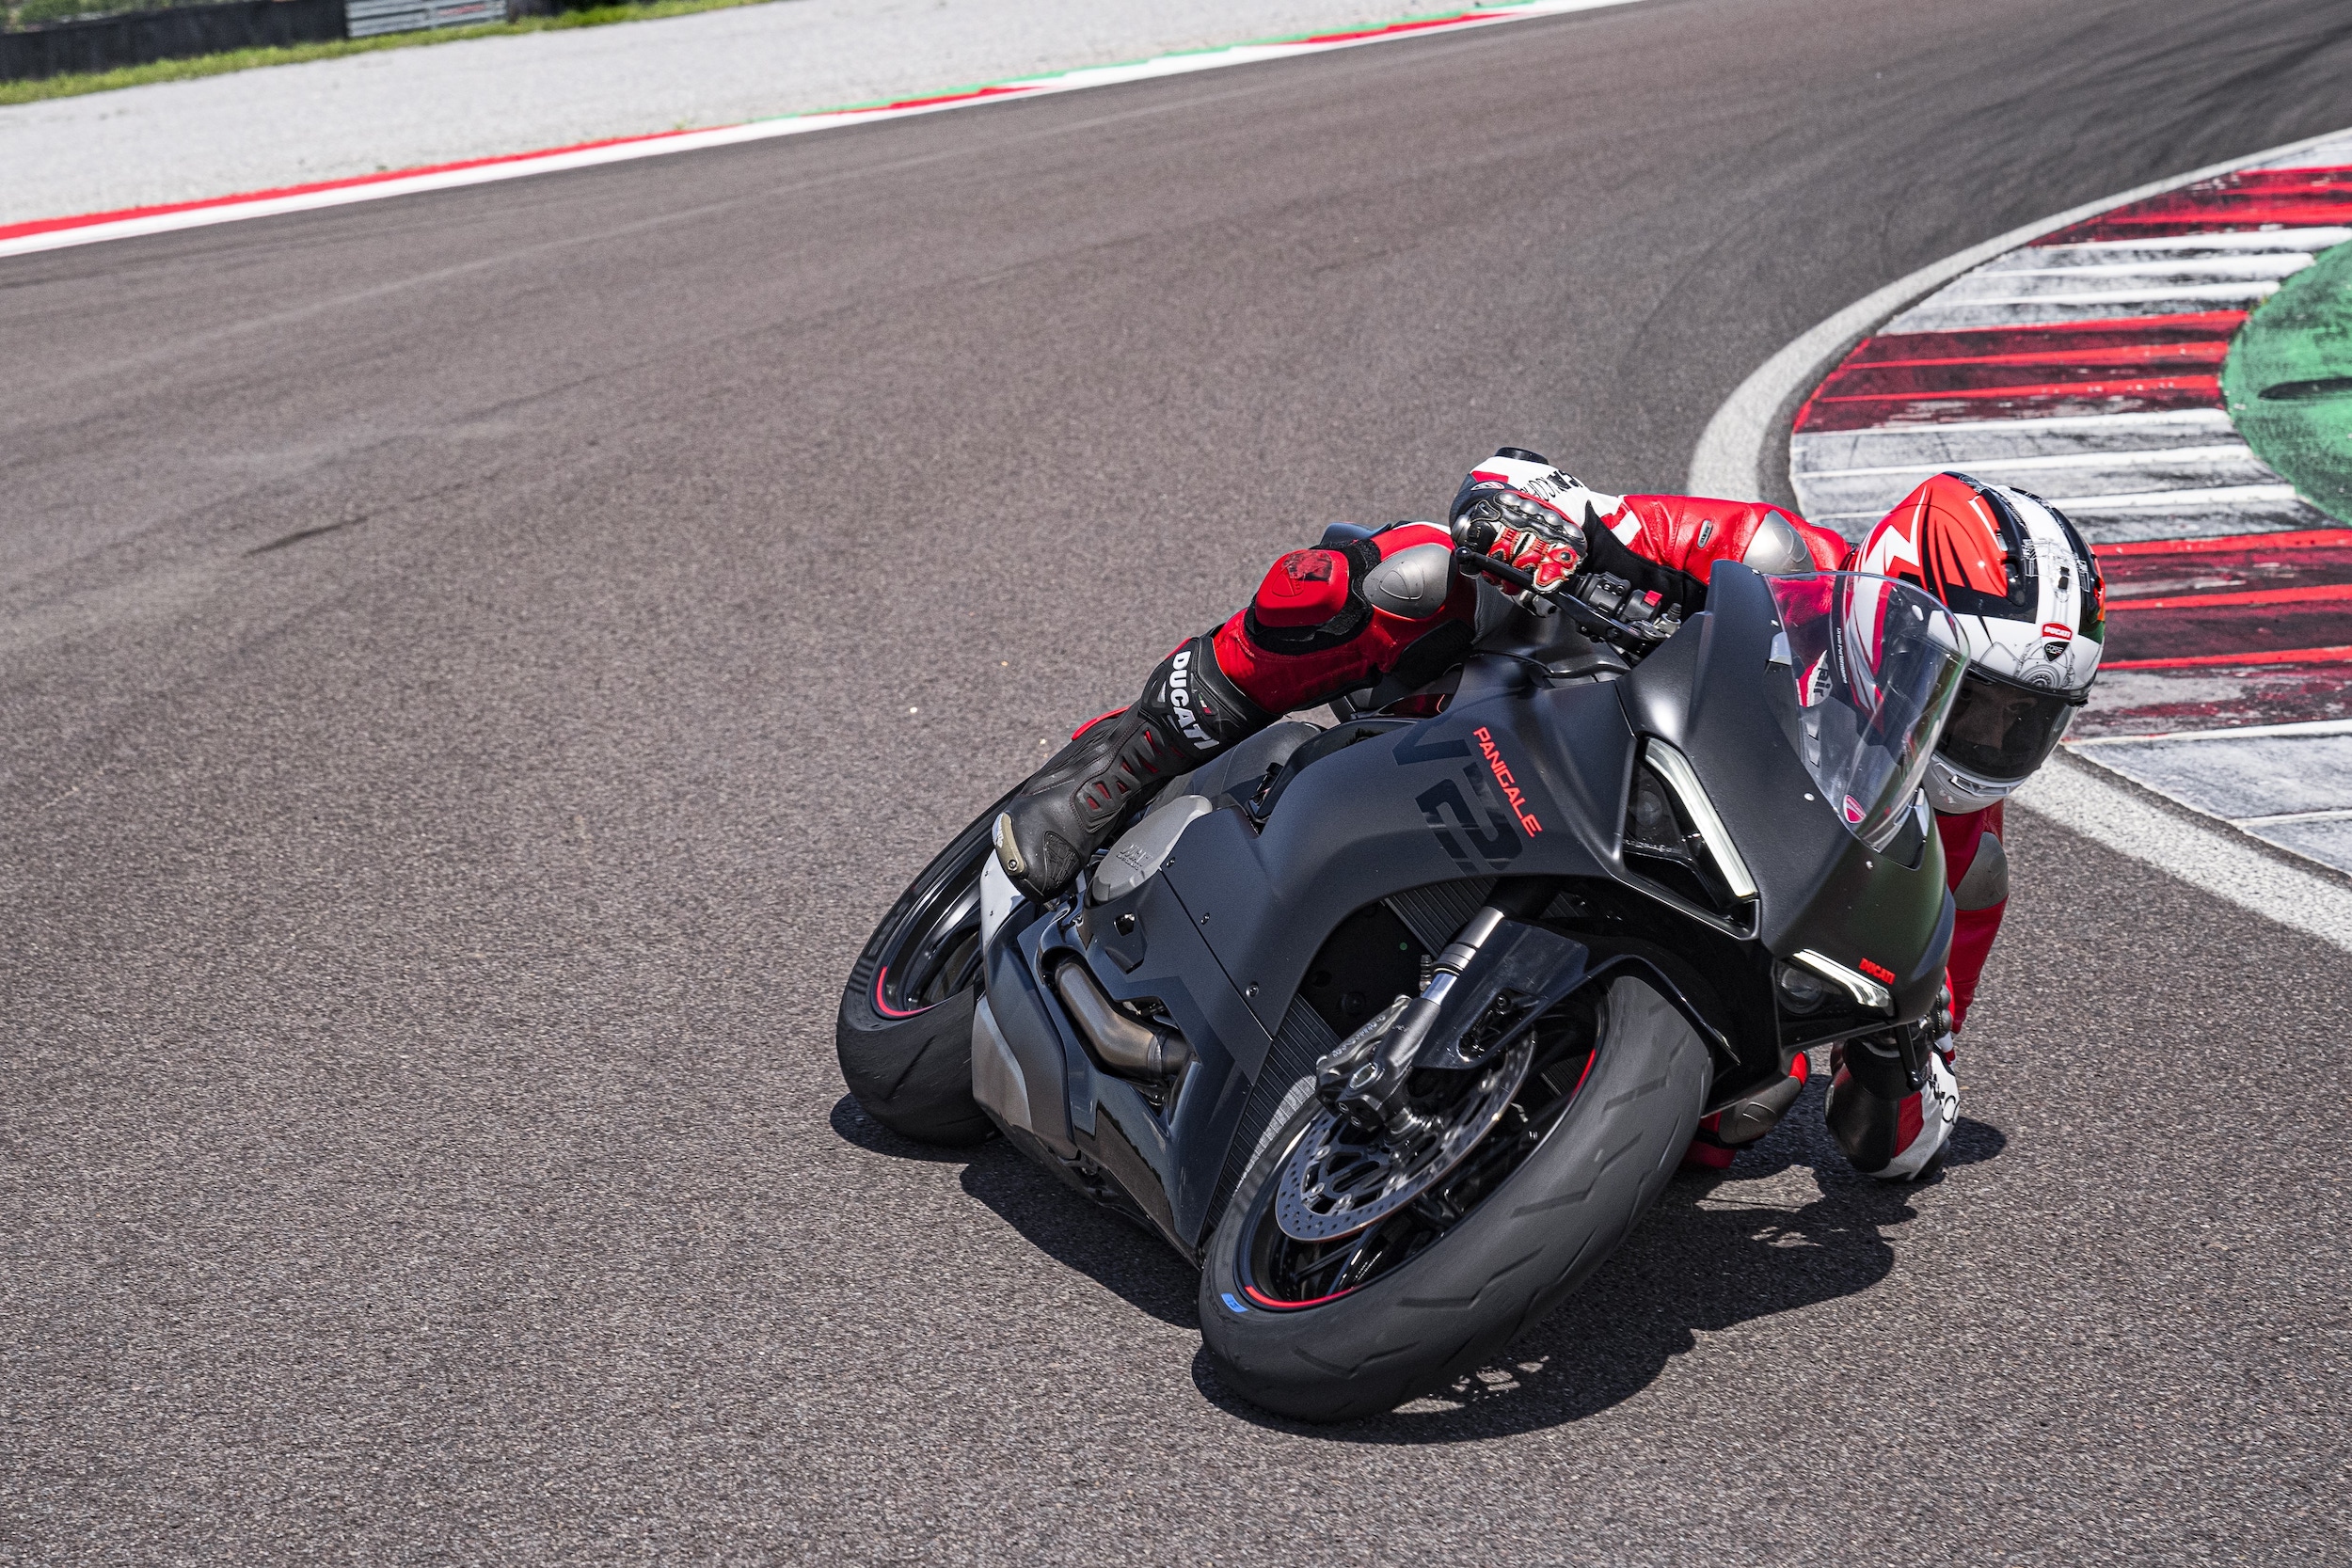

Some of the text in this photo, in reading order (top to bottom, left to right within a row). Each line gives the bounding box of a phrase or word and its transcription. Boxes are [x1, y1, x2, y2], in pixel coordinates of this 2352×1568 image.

[2043, 626, 2073, 639] DUCATI
[1169, 651, 1220, 751] DUCATI
[1391, 712, 1523, 875] V2
[1472, 726, 1544, 839] PANIGALE
[1858, 957, 1897, 986] DUCATI
